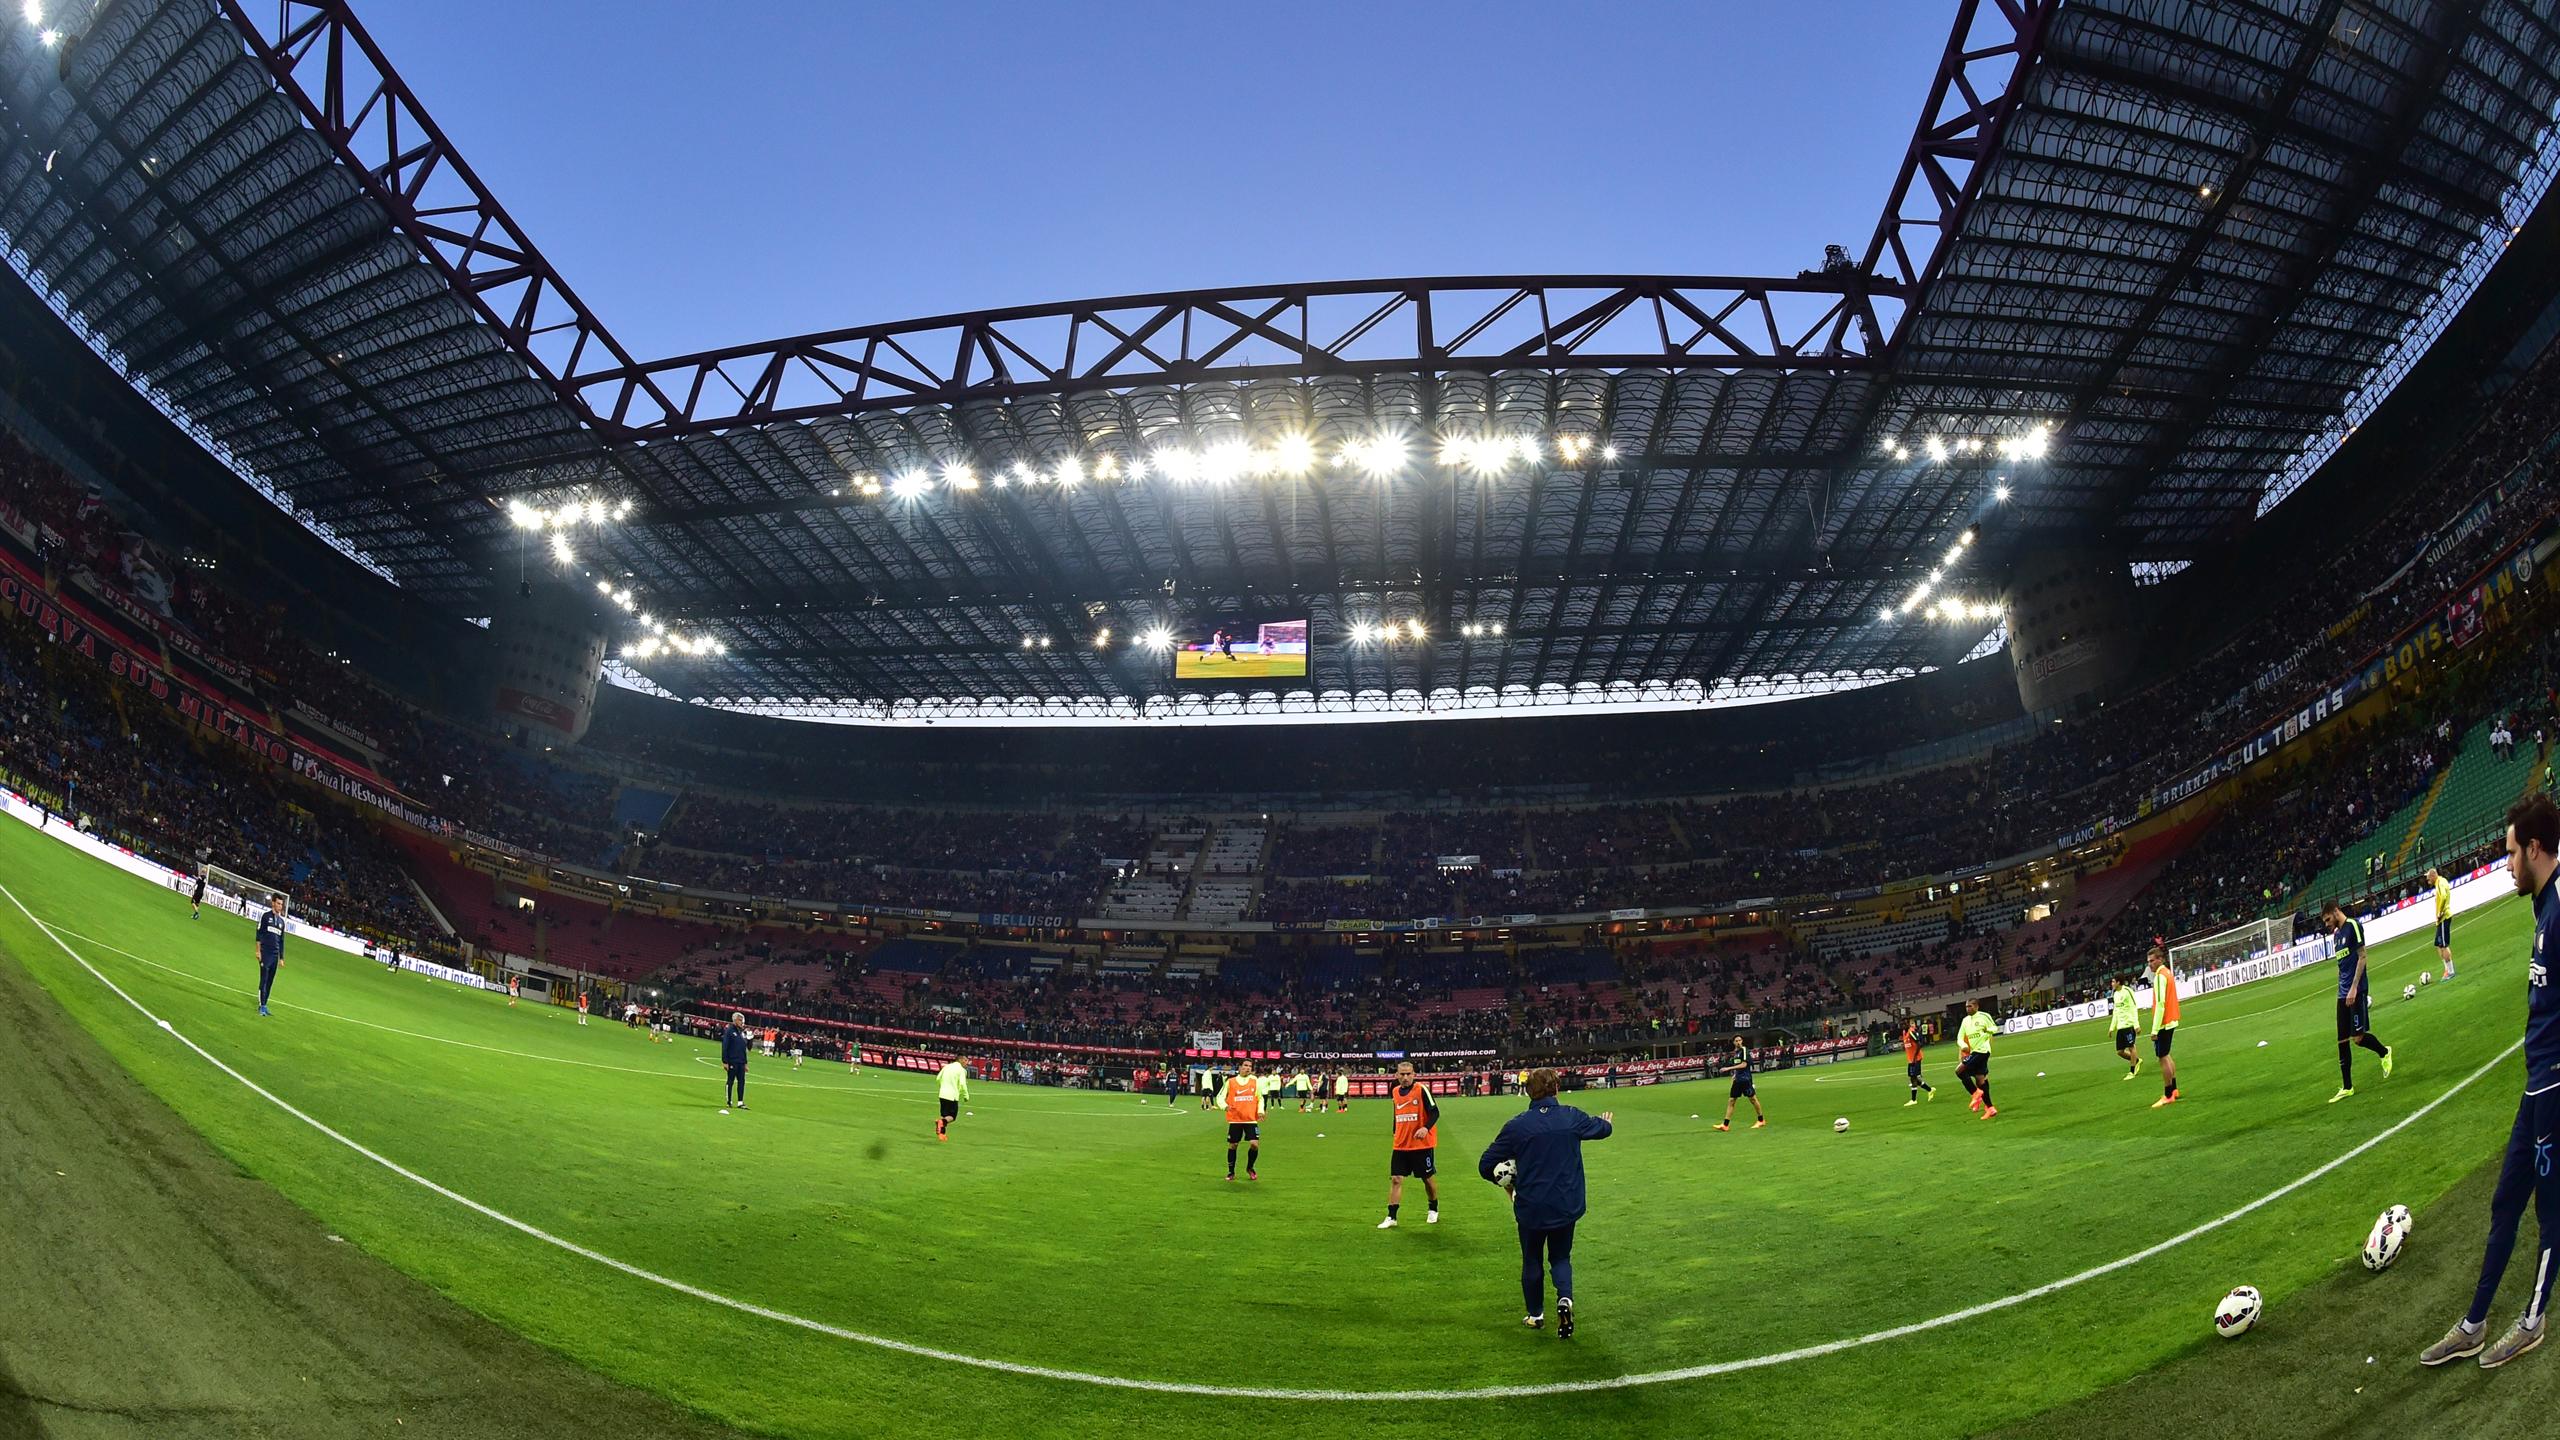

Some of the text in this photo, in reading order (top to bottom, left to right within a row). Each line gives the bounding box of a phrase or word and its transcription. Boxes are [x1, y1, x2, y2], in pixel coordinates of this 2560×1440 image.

[1, 577, 288, 765] CURVA SUD MILANO
[2384, 623, 2442, 682] BOYS
[2242, 687, 2344, 766] ULTRAS
[339, 773, 351, 795] Te
[404, 807, 428, 829] vuote
[2162, 765, 2219, 806] BRIANZA
[2058, 826, 2096, 851] MILANO
[993, 913, 1062, 928] BELLUSCO
[378, 949, 413, 971] int.it
[415, 958, 448, 979] inter.it
[451, 969, 482, 989] inter.it
[2241, 962, 2258, 983] CLUB
[2281, 953, 2291, 972] DA
[1303, 1051, 1340, 1060] caruso
[1410, 1048, 1497, 1058] www.tecnovision.com
[1585, 1067, 1604, 1076] Lete
[1626, 1064, 1645, 1073] Lete
[1645, 1062, 1664, 1071] Lete
[1666, 1060, 1685, 1069] Lete
[1685, 1057, 1704, 1067] Lete
[2534, 1143, 2553, 1177] 75
